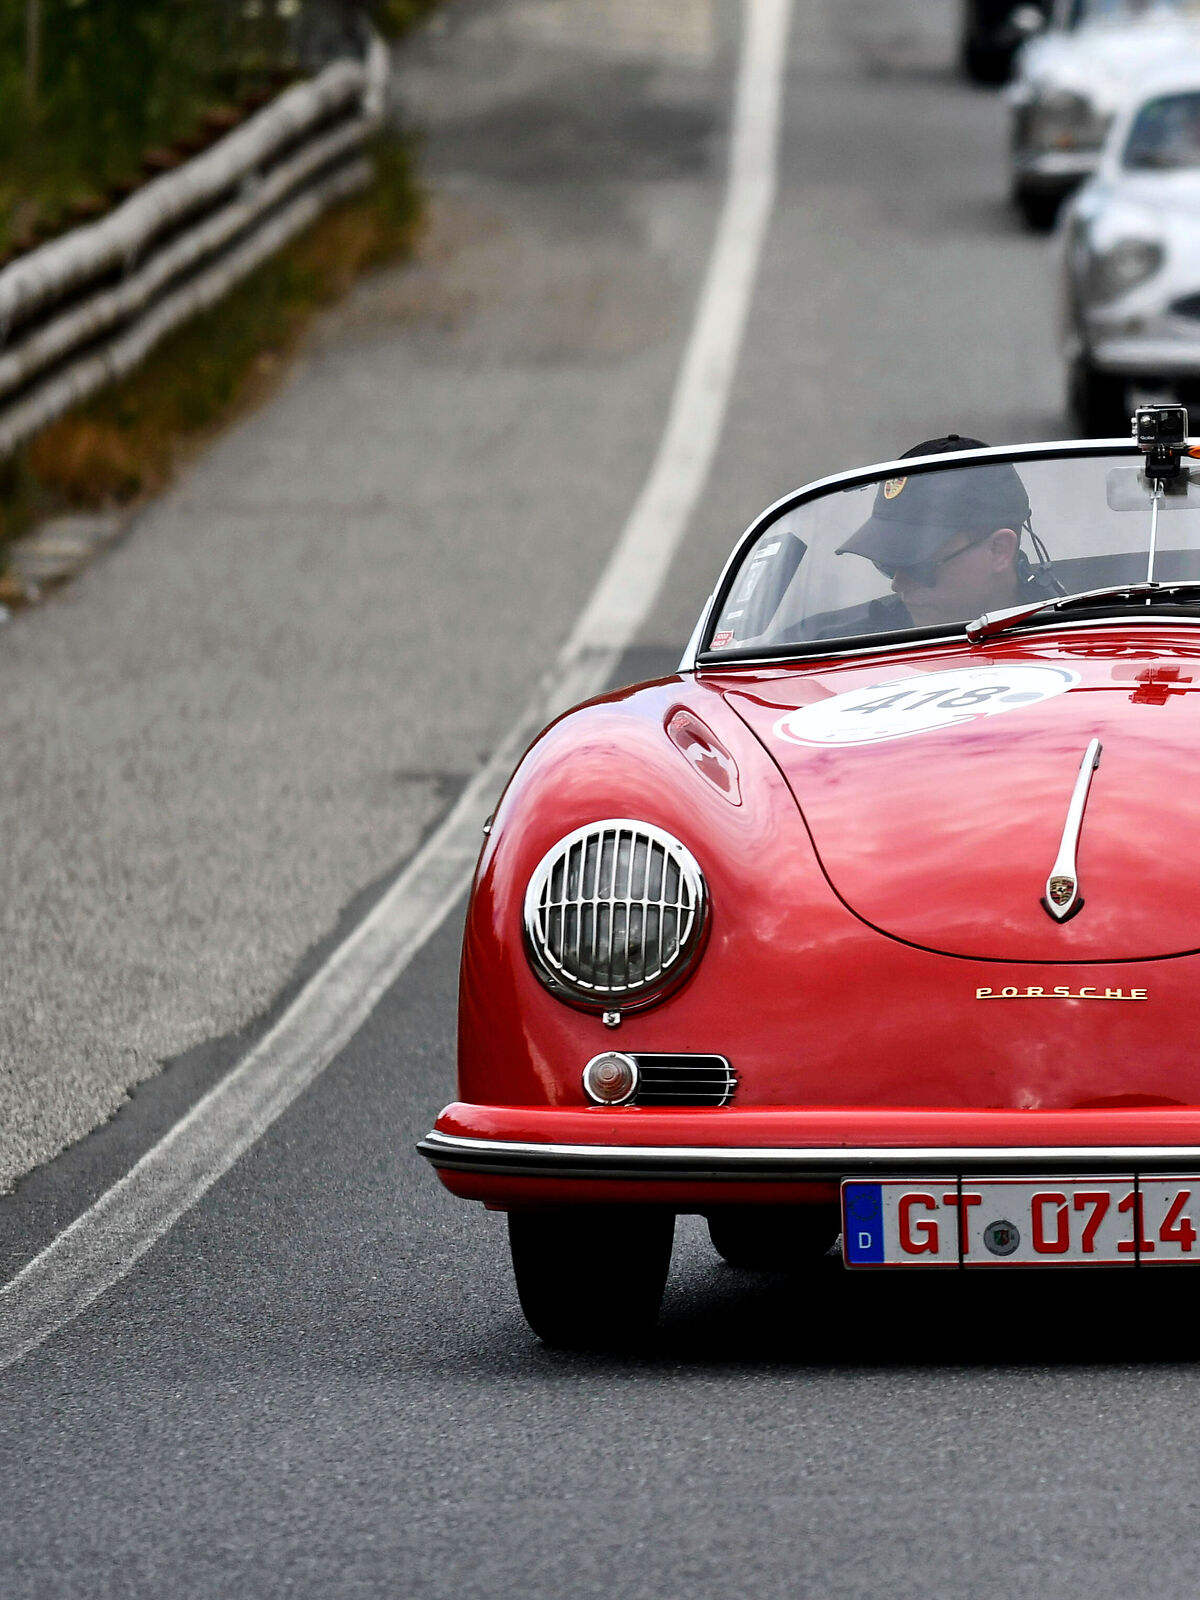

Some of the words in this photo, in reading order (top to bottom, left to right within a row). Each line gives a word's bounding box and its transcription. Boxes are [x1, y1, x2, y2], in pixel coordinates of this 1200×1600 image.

[842, 686, 1011, 715] 418
[976, 986, 1148, 999] PORSCHE
[898, 1192, 982, 1255] GT
[858, 1232, 872, 1250] D
